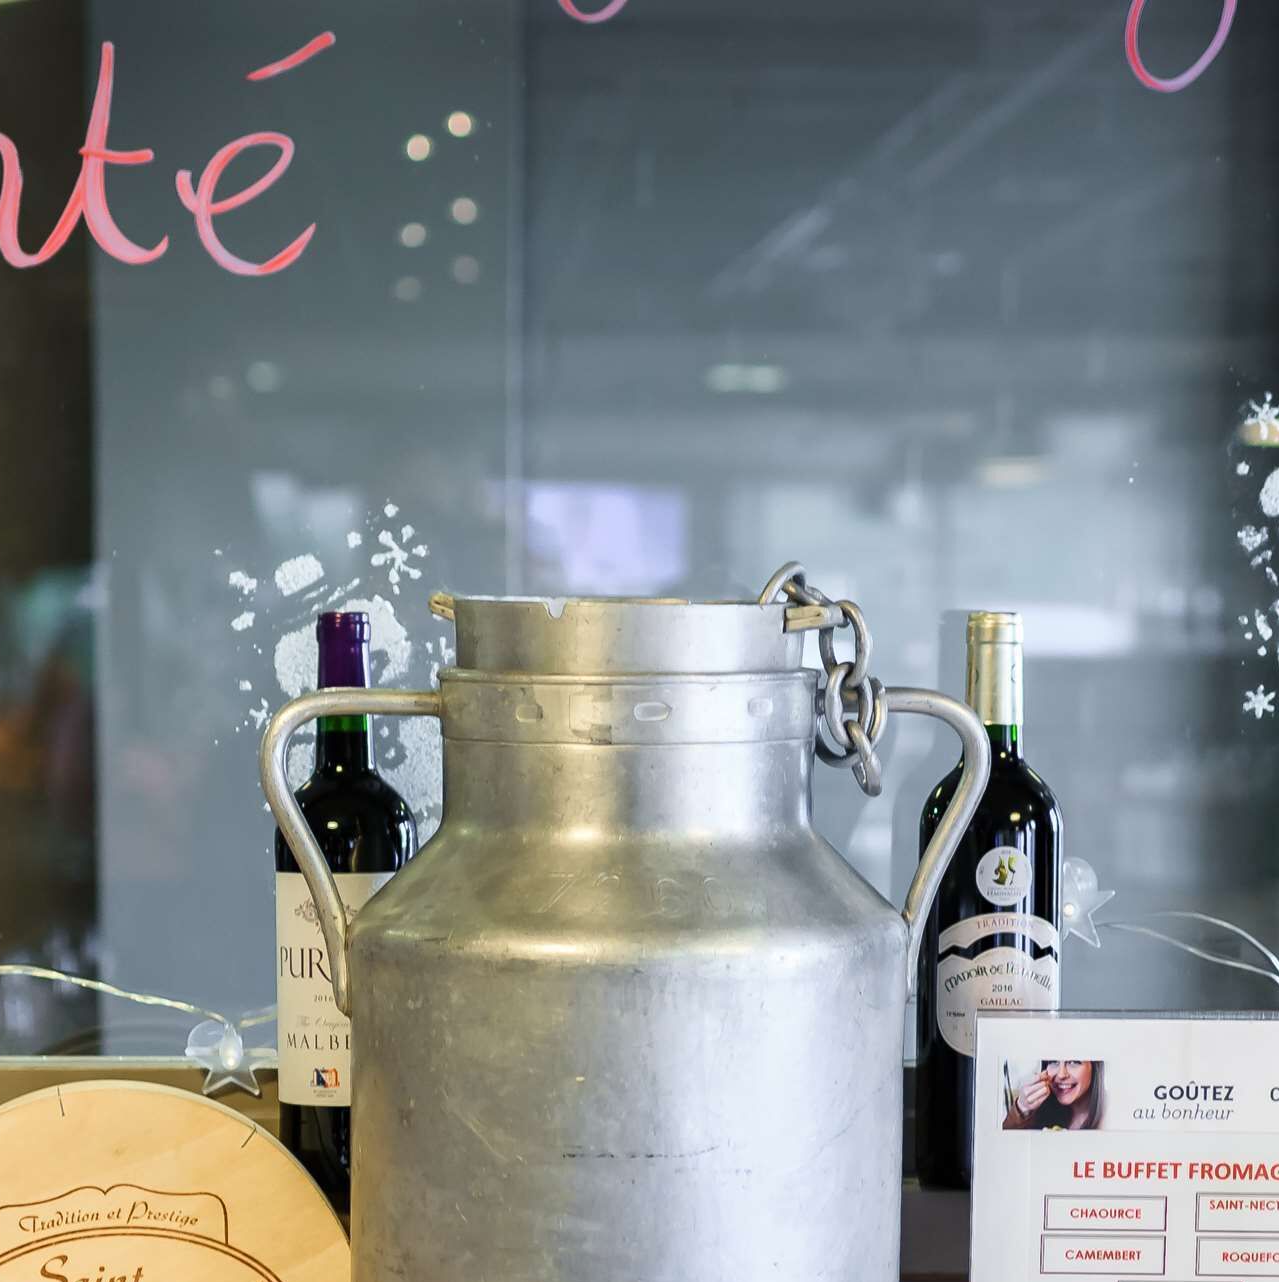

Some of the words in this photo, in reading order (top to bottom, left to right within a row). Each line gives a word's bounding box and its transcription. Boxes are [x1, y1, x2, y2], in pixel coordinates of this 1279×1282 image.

[280, 945, 333, 984] PUR
[992, 984, 1014, 993] 2016
[980, 997, 1023, 1007] GAILLAC
[286, 1032, 351, 1051] MALB
[1153, 1080, 1235, 1102] GOÛTEZ
[1132, 1105, 1157, 1121] au
[1161, 1103, 1235, 1121] bonheur
[1072, 1161, 1096, 1179] LE
[1102, 1161, 1182, 1181] BUFFET
[18, 1210, 100, 1234] Tradition
[106, 1207, 122, 1220] et
[126, 1200, 200, 1228] Prestige
[1069, 1207, 1143, 1220] CHAOURCE
[1064, 1249, 1143, 1262] CAMEMBERT
